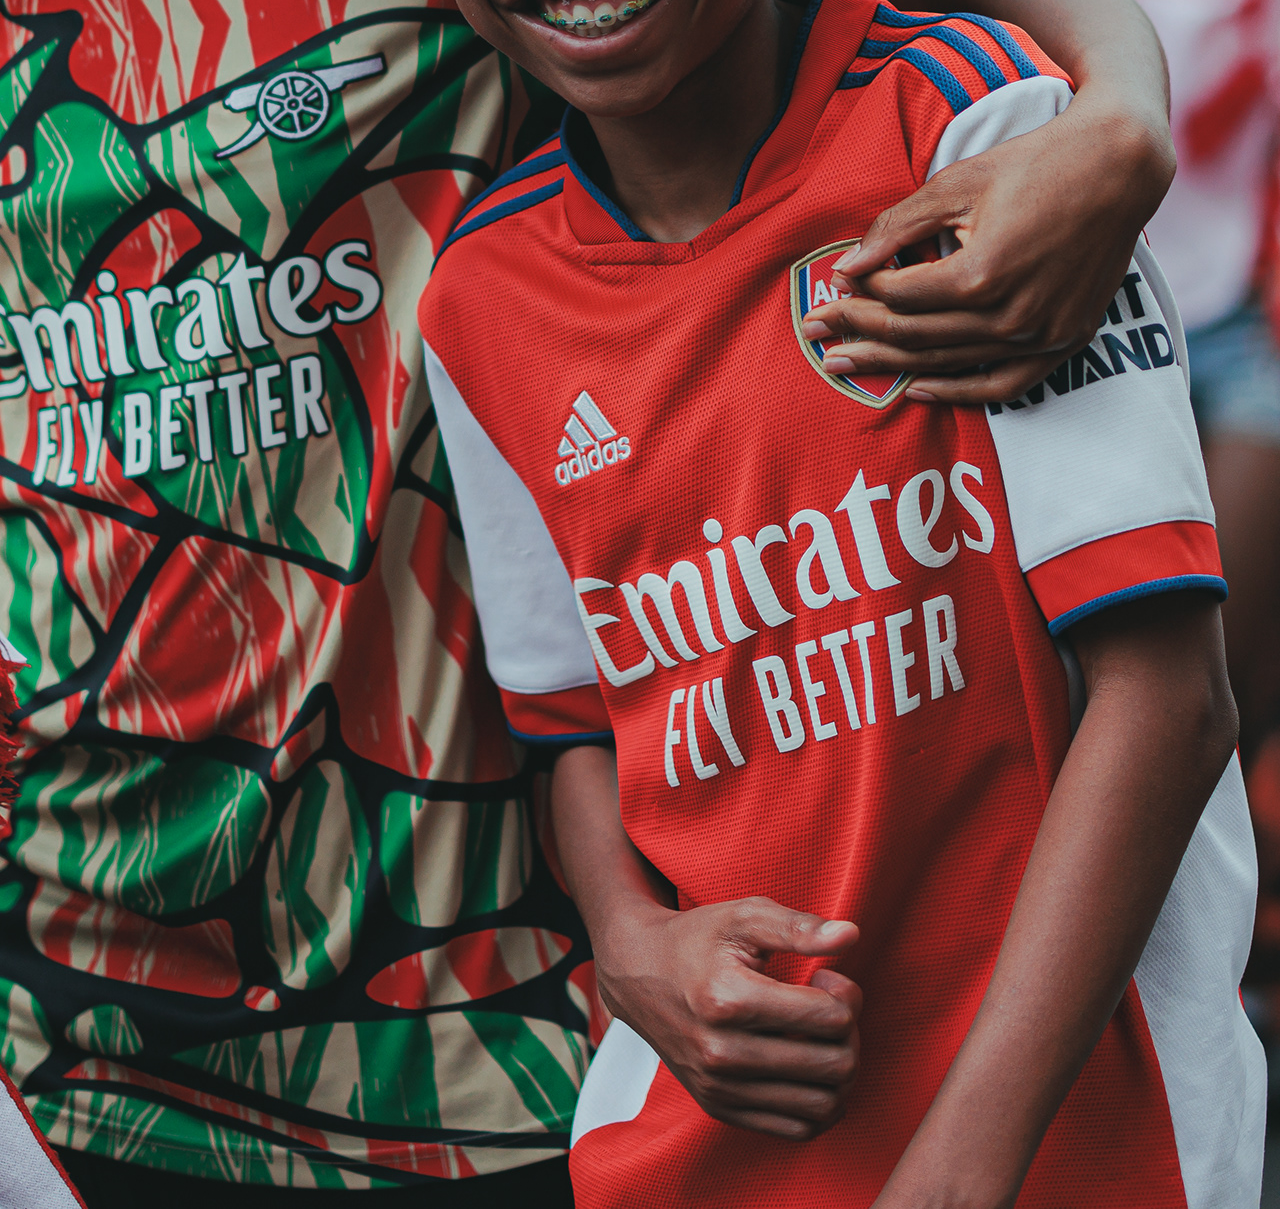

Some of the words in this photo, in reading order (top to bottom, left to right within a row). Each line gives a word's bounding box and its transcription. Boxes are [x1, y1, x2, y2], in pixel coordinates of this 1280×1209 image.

[31, 399, 104, 487] FLY
[122, 353, 329, 478] BETTER
[554, 436, 631, 486] adidas
[574, 460, 995, 688] Emirates
[663, 677, 747, 788] FLY
[751, 594, 966, 754] BETTER
